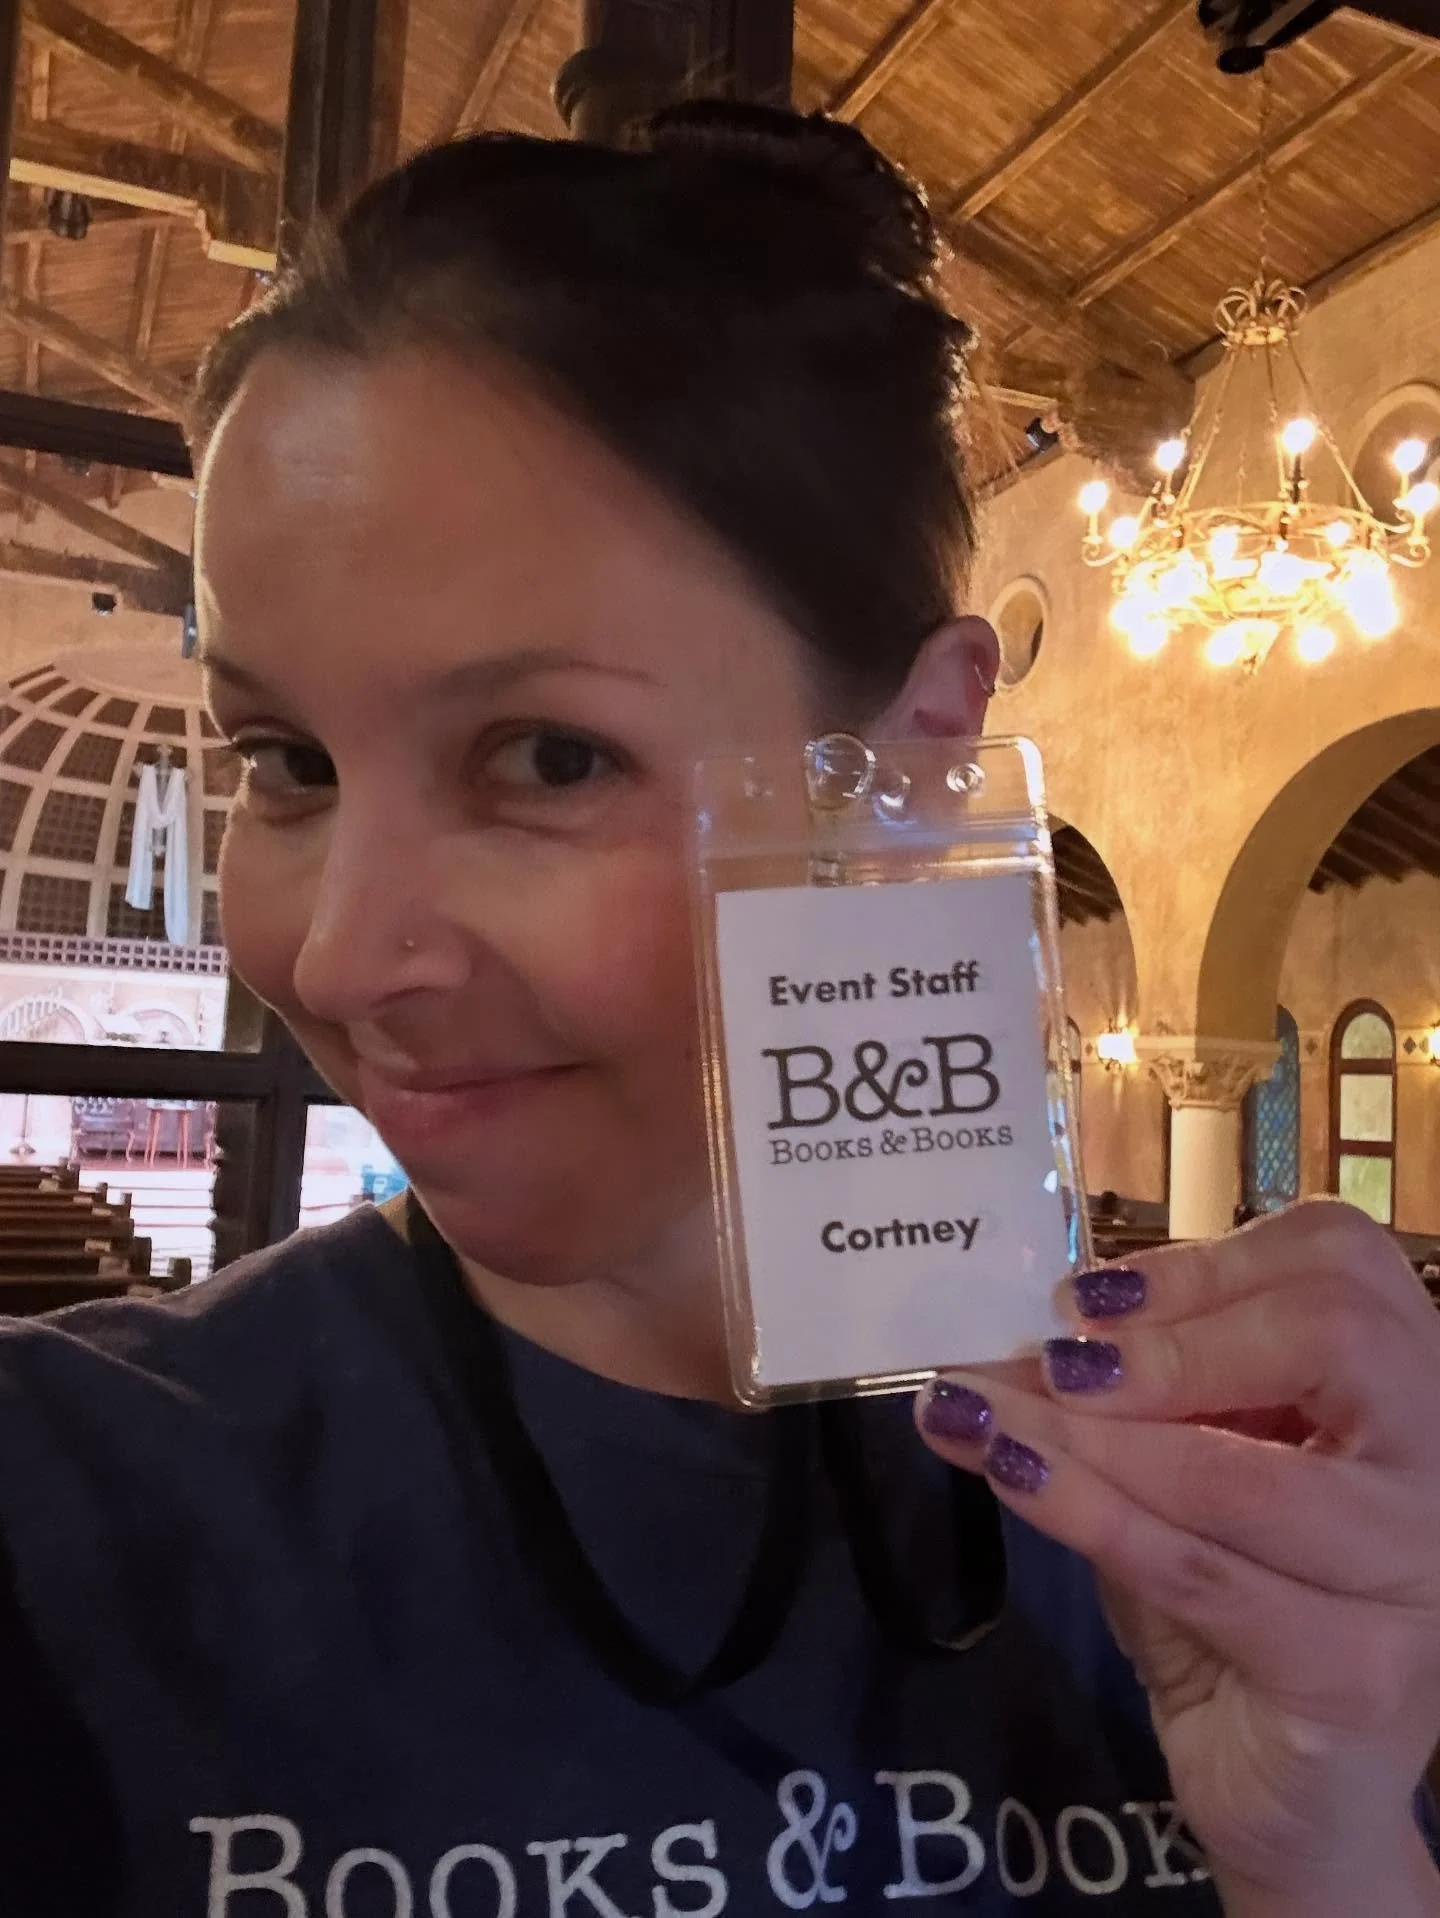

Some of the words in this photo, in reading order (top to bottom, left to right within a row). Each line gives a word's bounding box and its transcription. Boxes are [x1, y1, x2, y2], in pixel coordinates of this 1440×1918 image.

[769, 973, 876, 1006] Event
[889, 961, 980, 997] Staff
[761, 1033, 1001, 1130] B&B
[880, 1129, 908, 1155] &
[821, 1217, 980, 1254] Cortney
[767, 1769, 859, 1910] &
[874, 1769, 1211, 1900] BOOK
